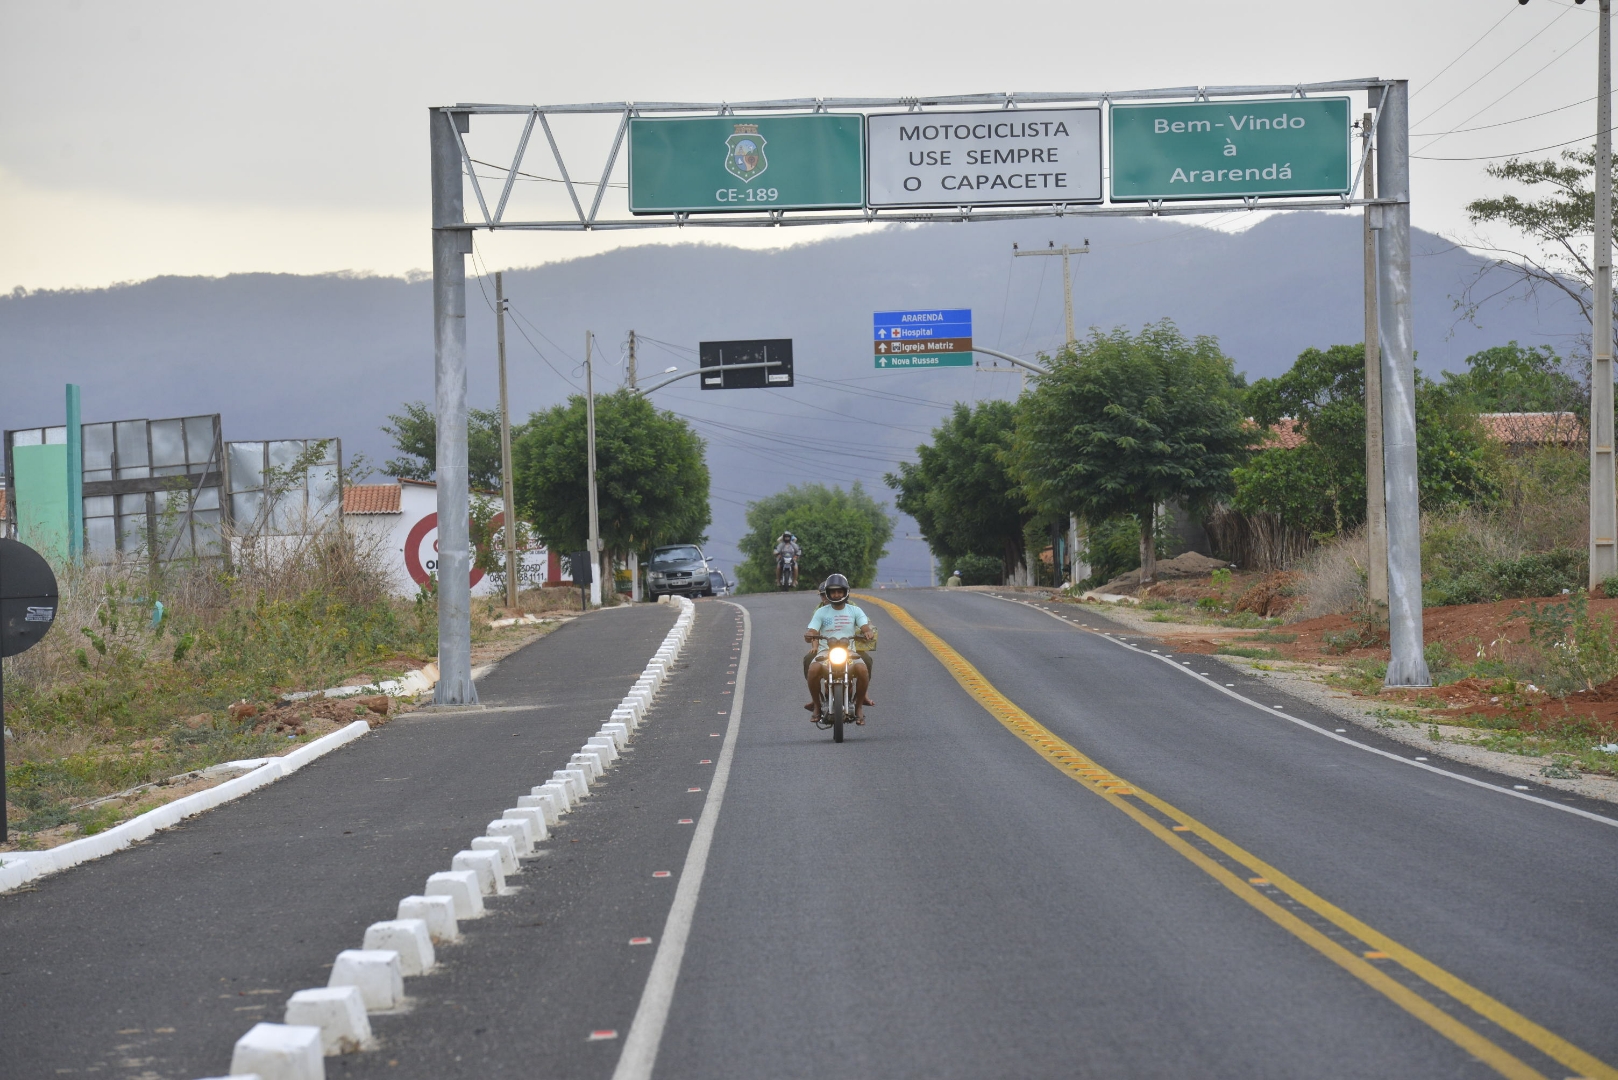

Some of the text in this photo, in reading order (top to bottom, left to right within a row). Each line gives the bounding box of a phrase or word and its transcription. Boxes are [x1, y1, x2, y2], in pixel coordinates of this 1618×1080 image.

[899, 121, 1070, 141] MOTOCICLISTA
[1154, 113, 1306, 134] Bem-Vindo
[909, 147, 1059, 166] USE SEMPRE
[1223, 137, 1237, 157] à
[903, 172, 1068, 192] O CAPACETE
[1169, 162, 1292, 184] Ararendá
[715, 187, 779, 202] CE-189
[901, 312, 944, 323] ARARENDÁ
[901, 328, 933, 337] Hospital
[902, 341, 954, 352] Igreja Matriz
[891, 356, 939, 366] Nova Russas
